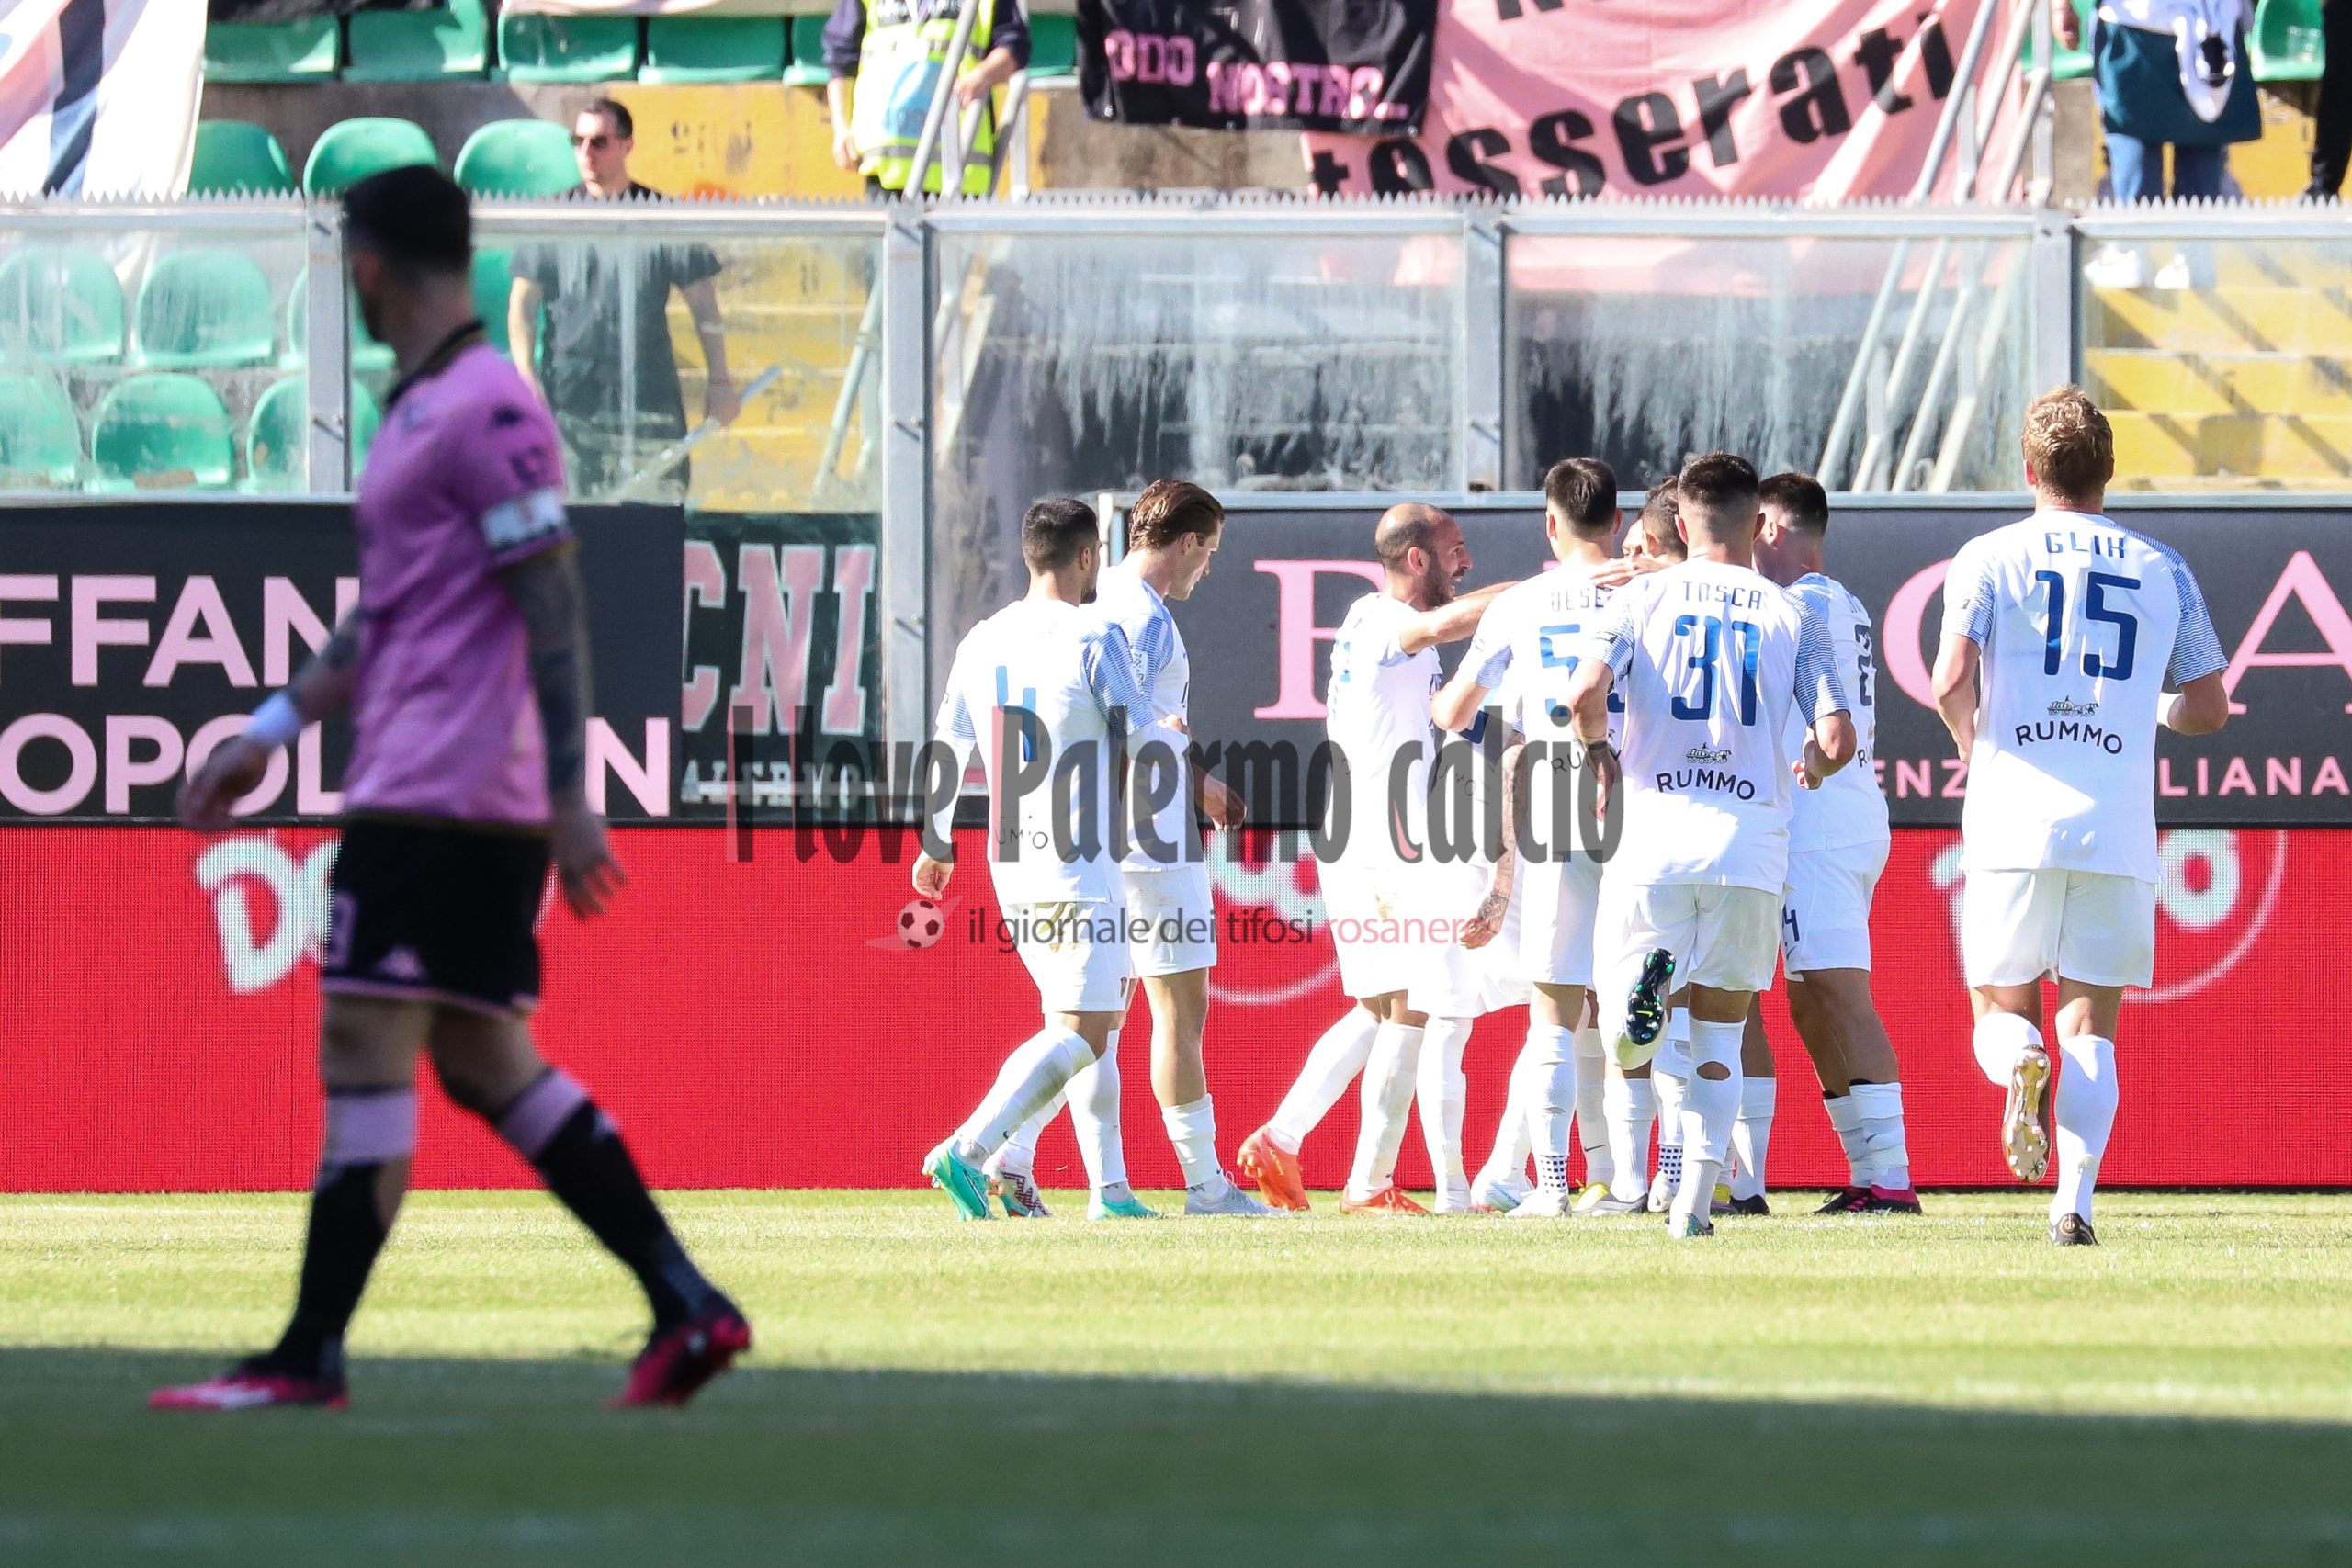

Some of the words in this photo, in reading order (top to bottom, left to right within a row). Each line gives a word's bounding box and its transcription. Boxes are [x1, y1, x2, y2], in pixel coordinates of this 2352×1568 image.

[2035, 570, 2141, 681] 15
[1671, 614, 1761, 726] 31
[2015, 720, 2122, 754] RUMMO
[1656, 768, 1755, 801] RUMMO
